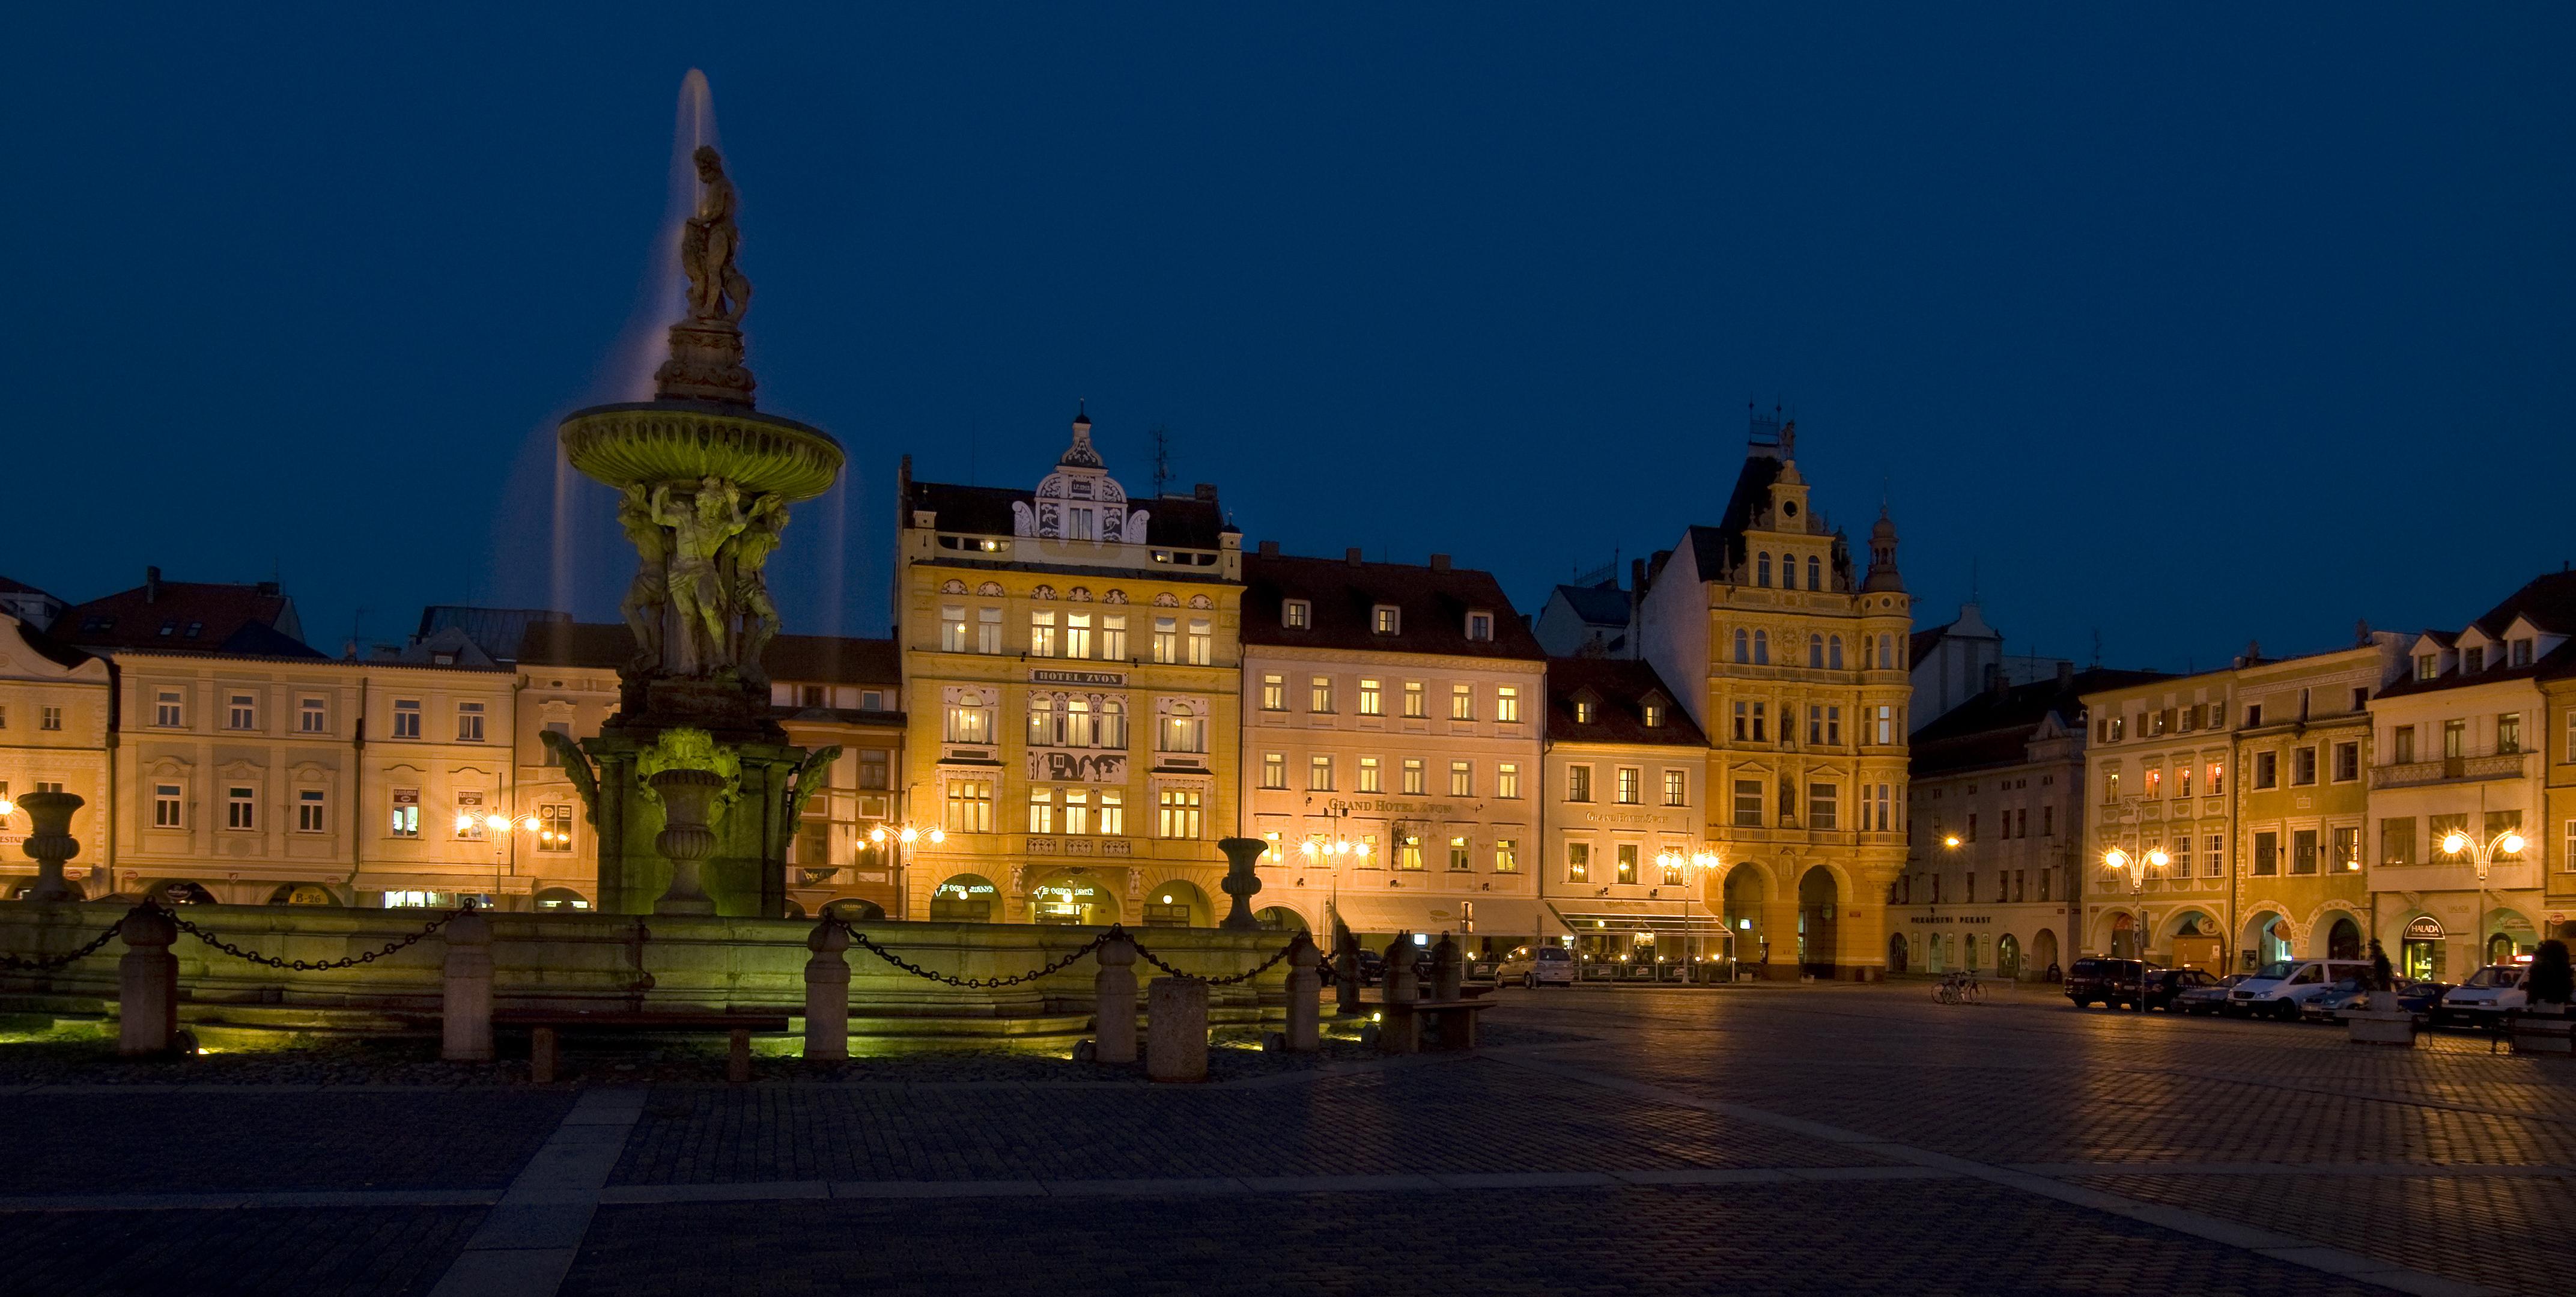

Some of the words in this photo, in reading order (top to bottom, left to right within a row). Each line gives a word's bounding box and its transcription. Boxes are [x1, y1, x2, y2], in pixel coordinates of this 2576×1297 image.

[1039, 672, 1081, 682] HOTEL
[1086, 673, 1117, 683] ZVON
[1375, 800, 1417, 813] HOTEL
[296, 893, 321, 903] B-26
